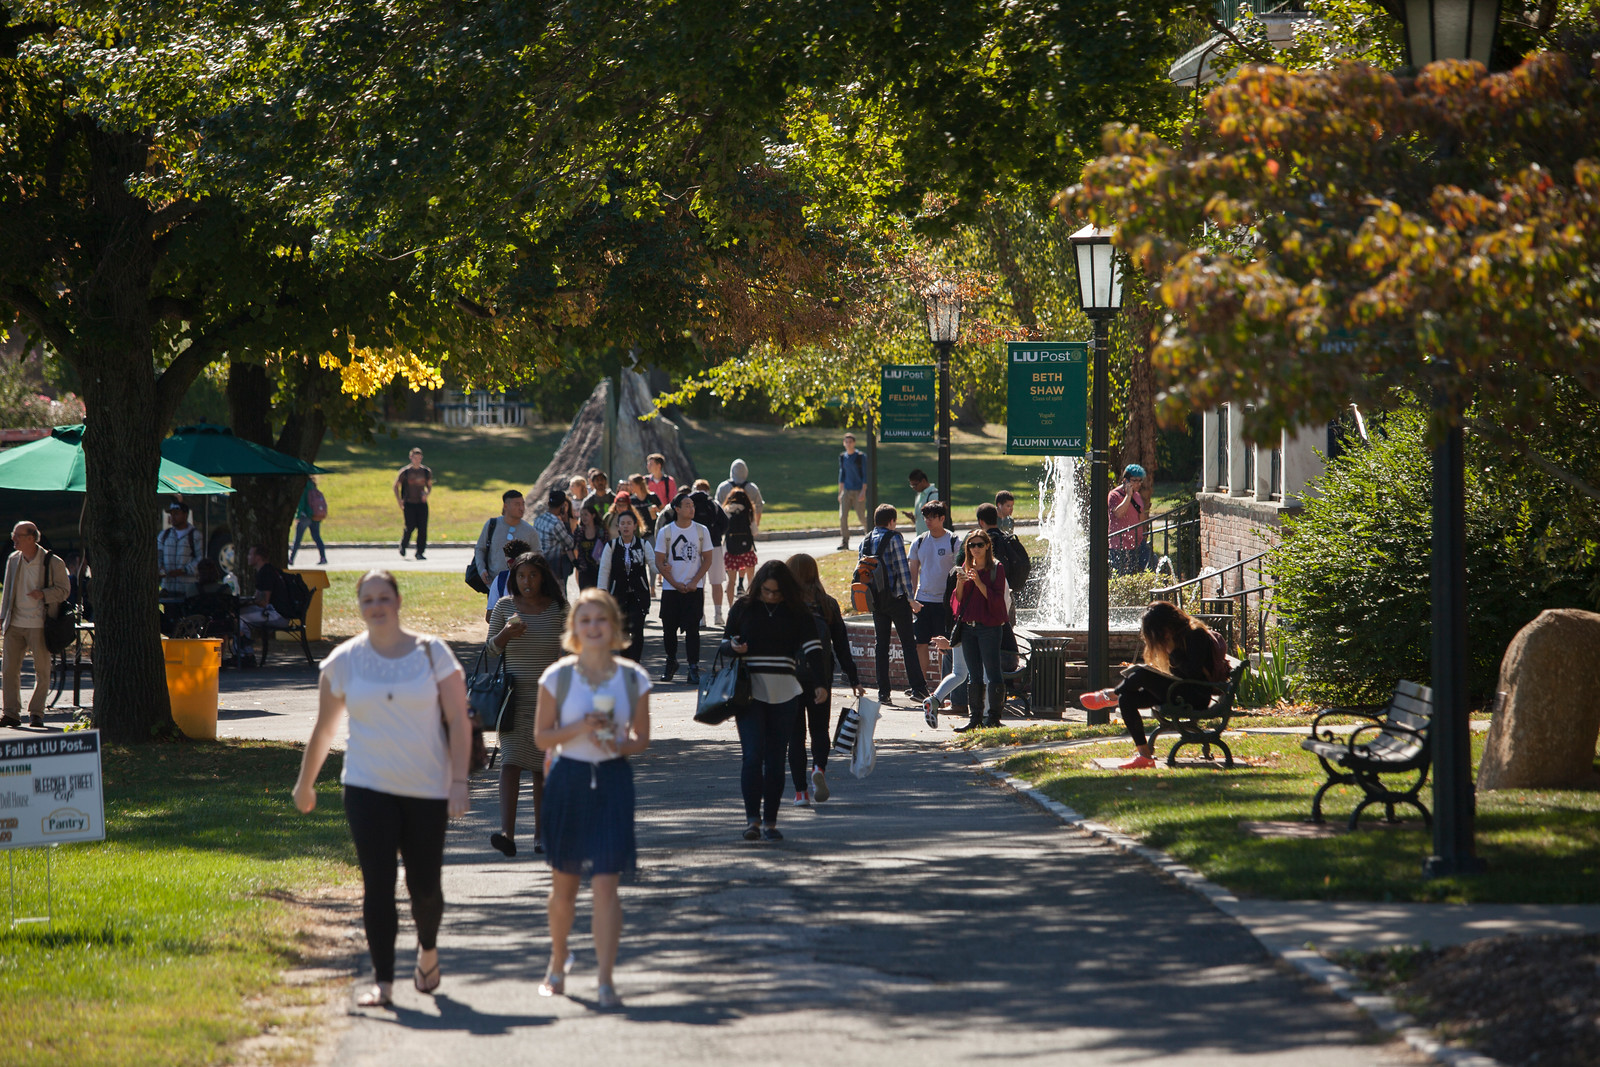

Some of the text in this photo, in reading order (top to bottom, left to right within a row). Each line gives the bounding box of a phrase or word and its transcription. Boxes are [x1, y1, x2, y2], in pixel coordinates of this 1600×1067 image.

[1013, 351, 1071, 362] LIU Post
[884, 370, 924, 379] LIU Post
[1032, 373, 1063, 382] BETH
[1030, 386, 1065, 395] SHAW
[1012, 439, 1081, 447] ALUMNI WALK
[631, 549, 645, 563] N
[5, 743, 24, 757] Fall
[27, 743, 38, 755] at
[40, 740, 58, 754] LIU
[49, 819, 84, 830] Pantry
